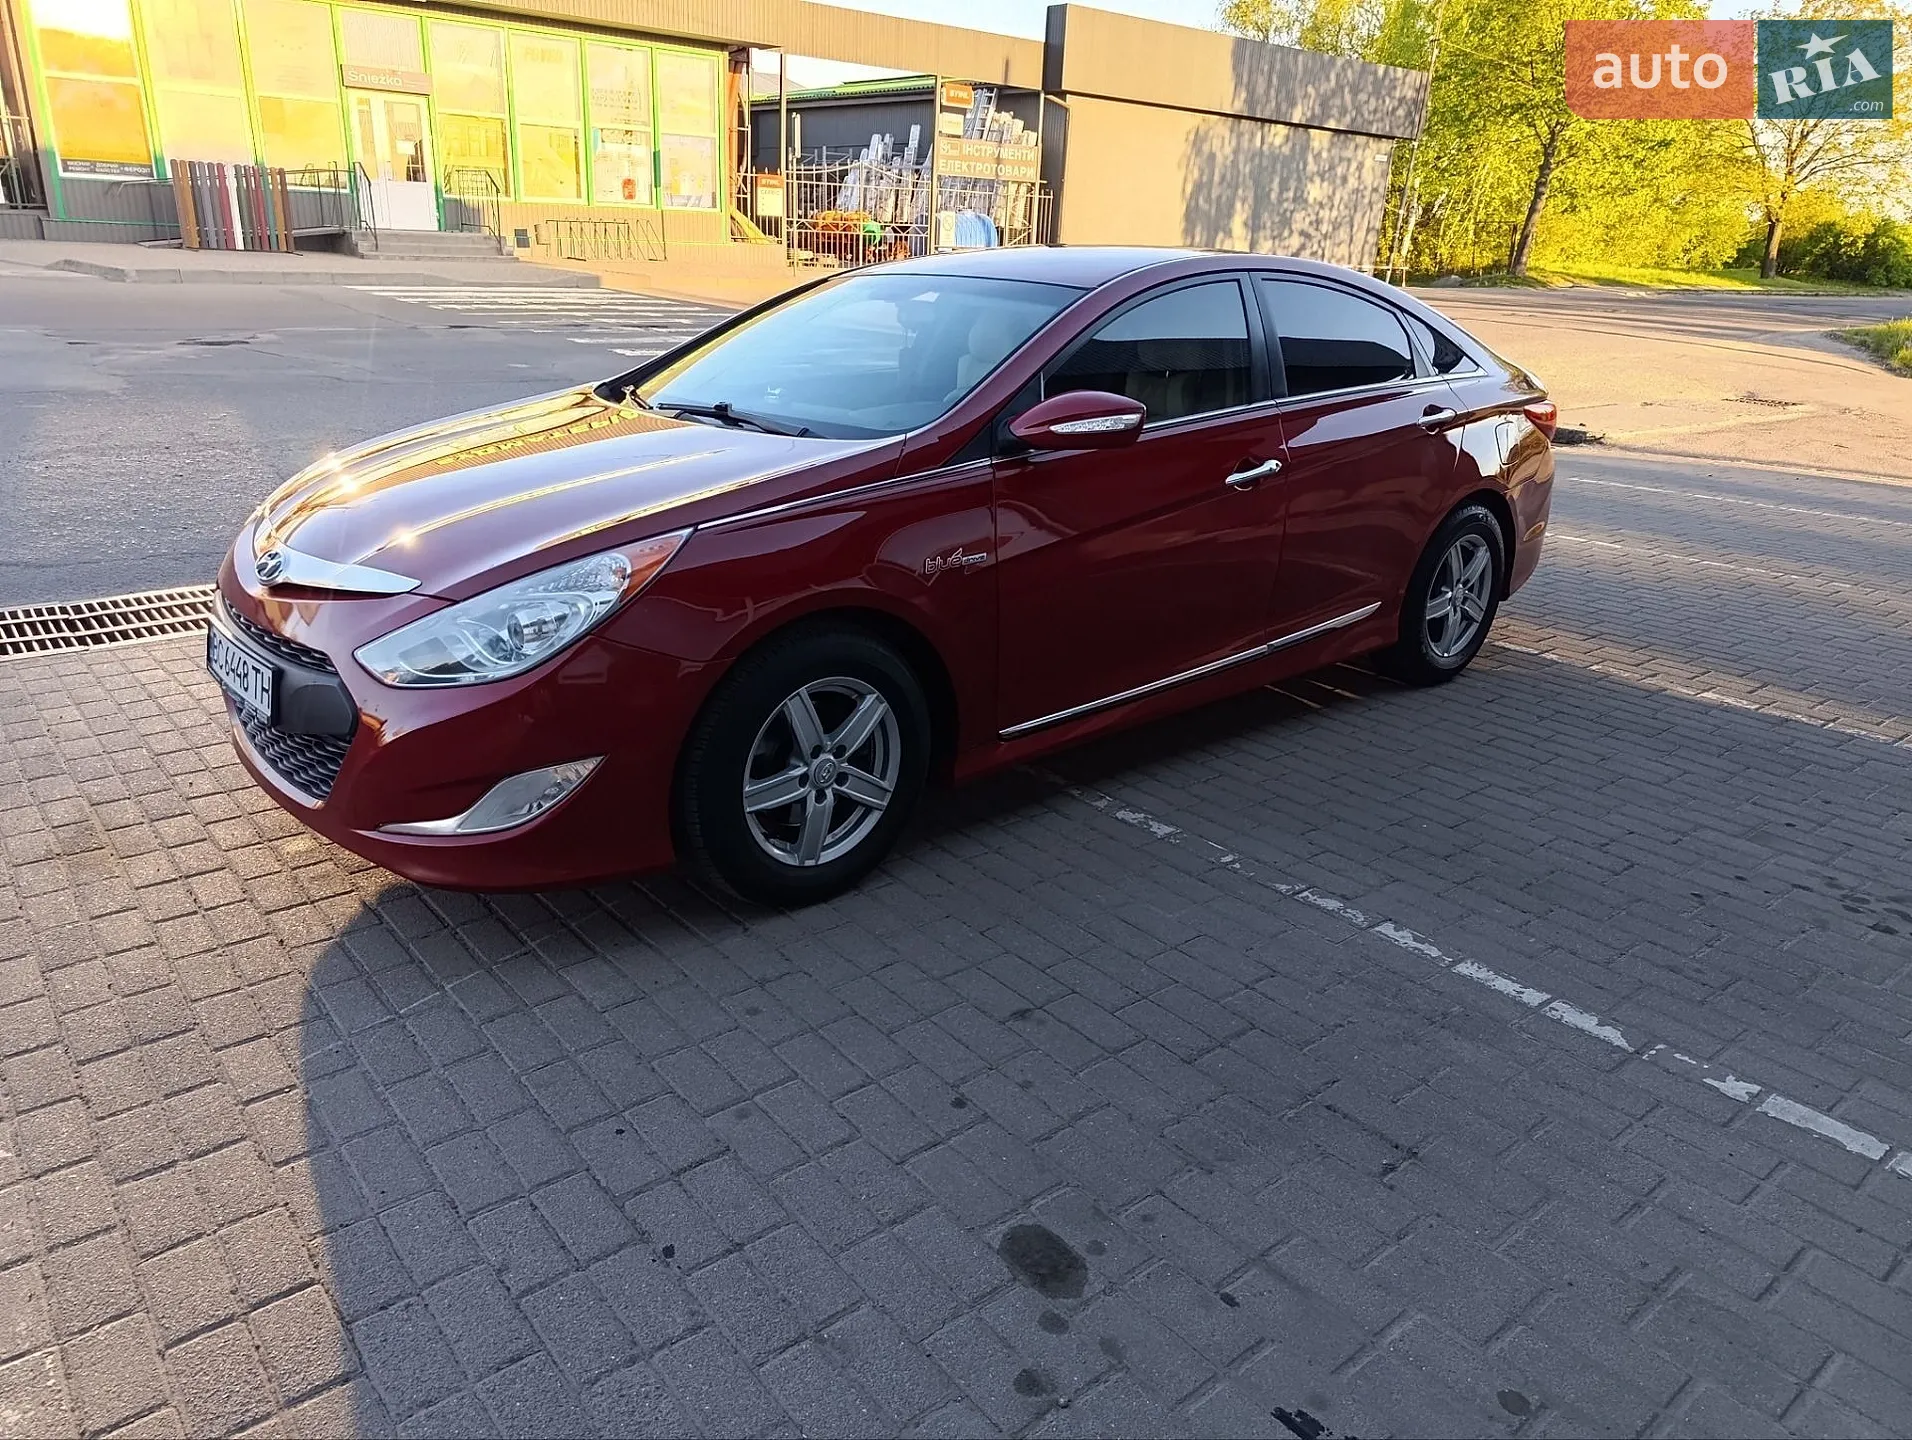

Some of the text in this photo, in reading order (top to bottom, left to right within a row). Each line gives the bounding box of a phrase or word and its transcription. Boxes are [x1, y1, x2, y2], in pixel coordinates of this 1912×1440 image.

[962, 144, 1035, 161] ІНСТРУМЕНТИ
[939, 160, 1035, 179] ЕЛЕКТРОТОВАРИ
[925, 548, 963, 575] blue
[225, 646, 249, 692] 6448
[251, 664, 271, 710] TH
